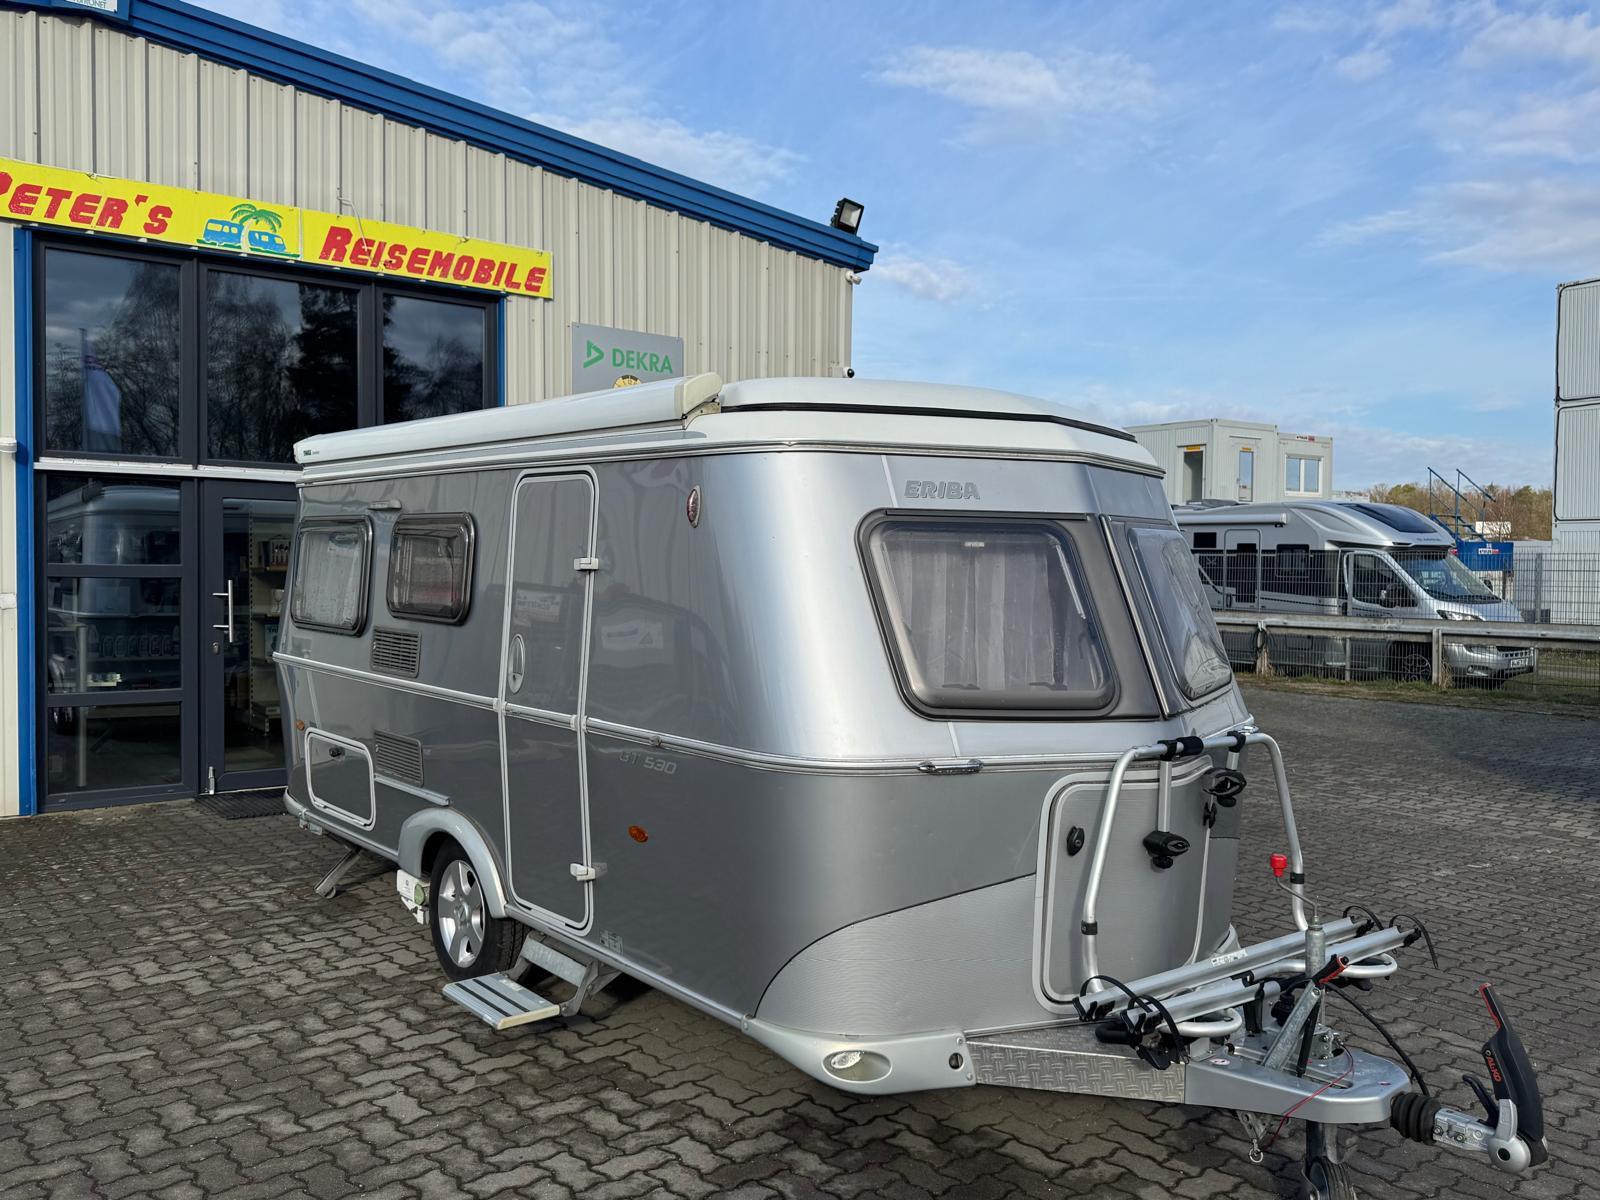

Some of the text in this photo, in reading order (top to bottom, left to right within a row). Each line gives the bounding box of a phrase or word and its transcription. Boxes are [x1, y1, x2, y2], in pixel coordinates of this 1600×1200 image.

[319, 225, 547, 293] REISEMOBILE
[612, 347, 673, 374] DEKRA
[904, 480, 981, 500] ERIBA
[643, 756, 677, 775] 530
